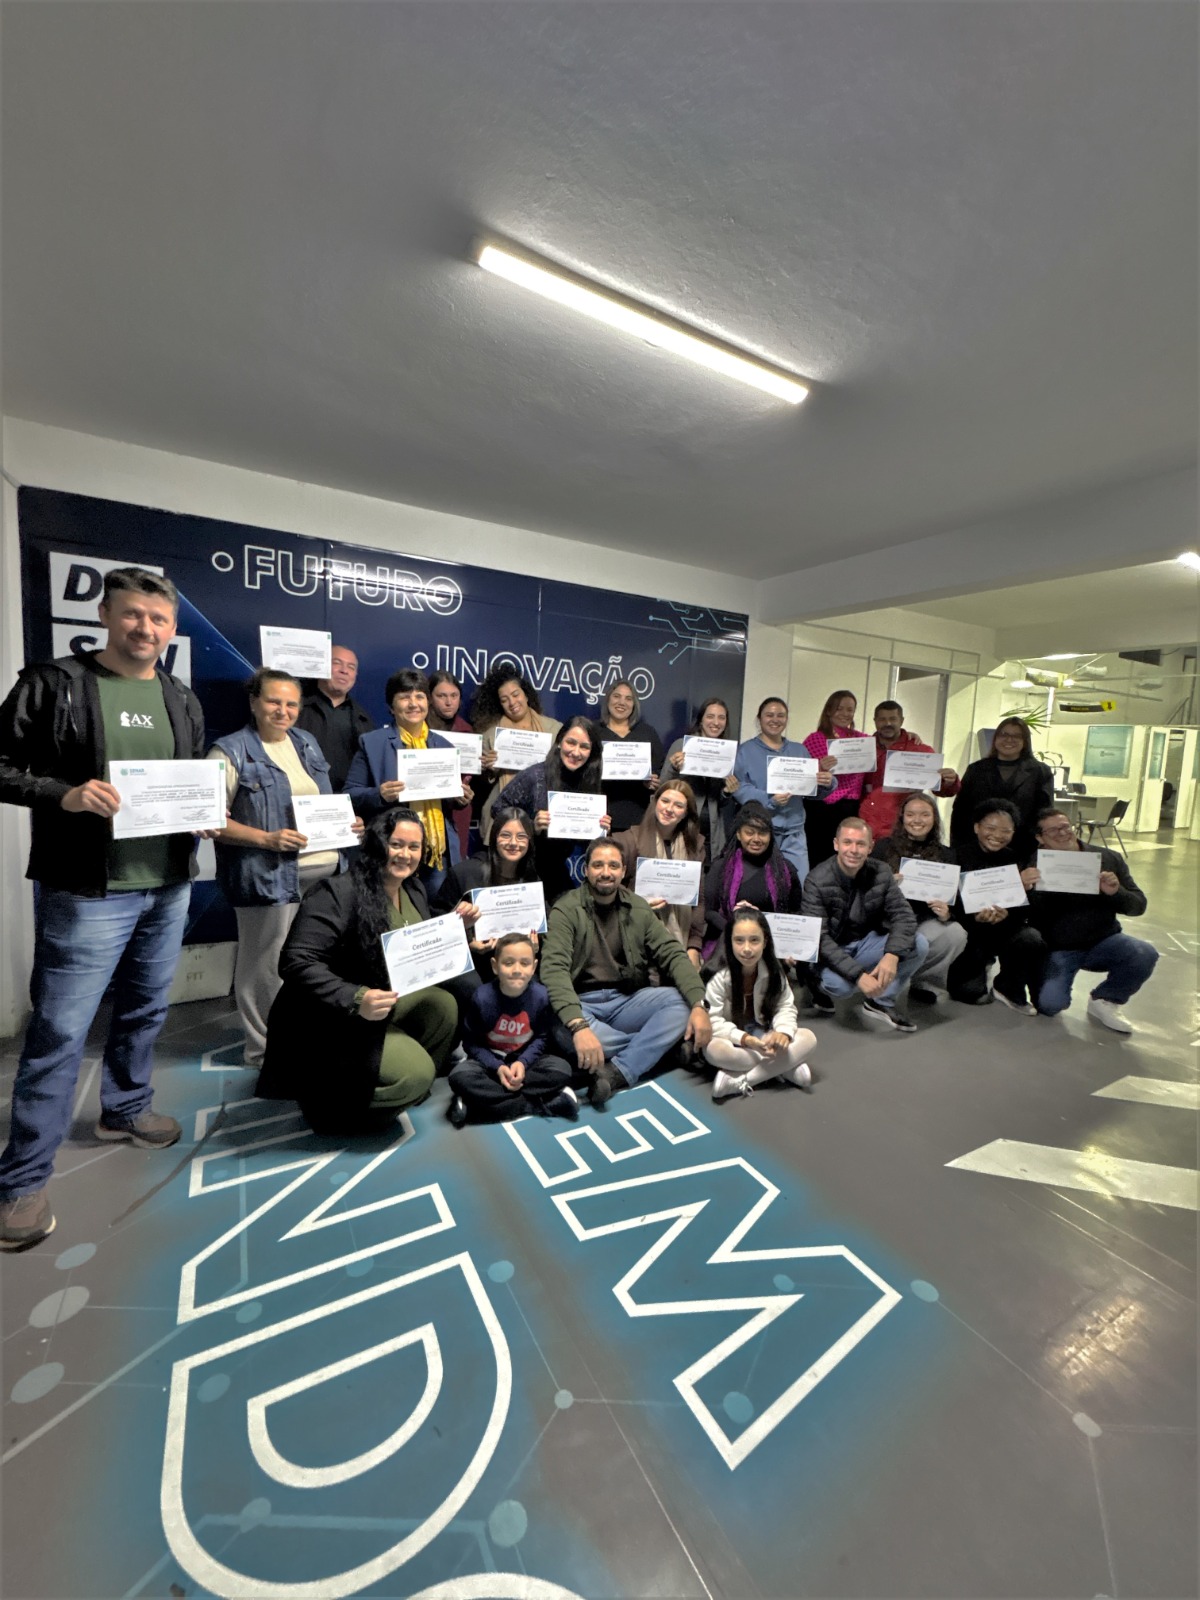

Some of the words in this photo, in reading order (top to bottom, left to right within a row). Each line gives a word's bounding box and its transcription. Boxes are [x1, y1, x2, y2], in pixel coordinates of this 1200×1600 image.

[244, 544, 463, 616] FUTURO
[131, 713, 154, 726] AX
[412, 937, 442, 951] Certificado
[498, 1018, 525, 1035] BOY
